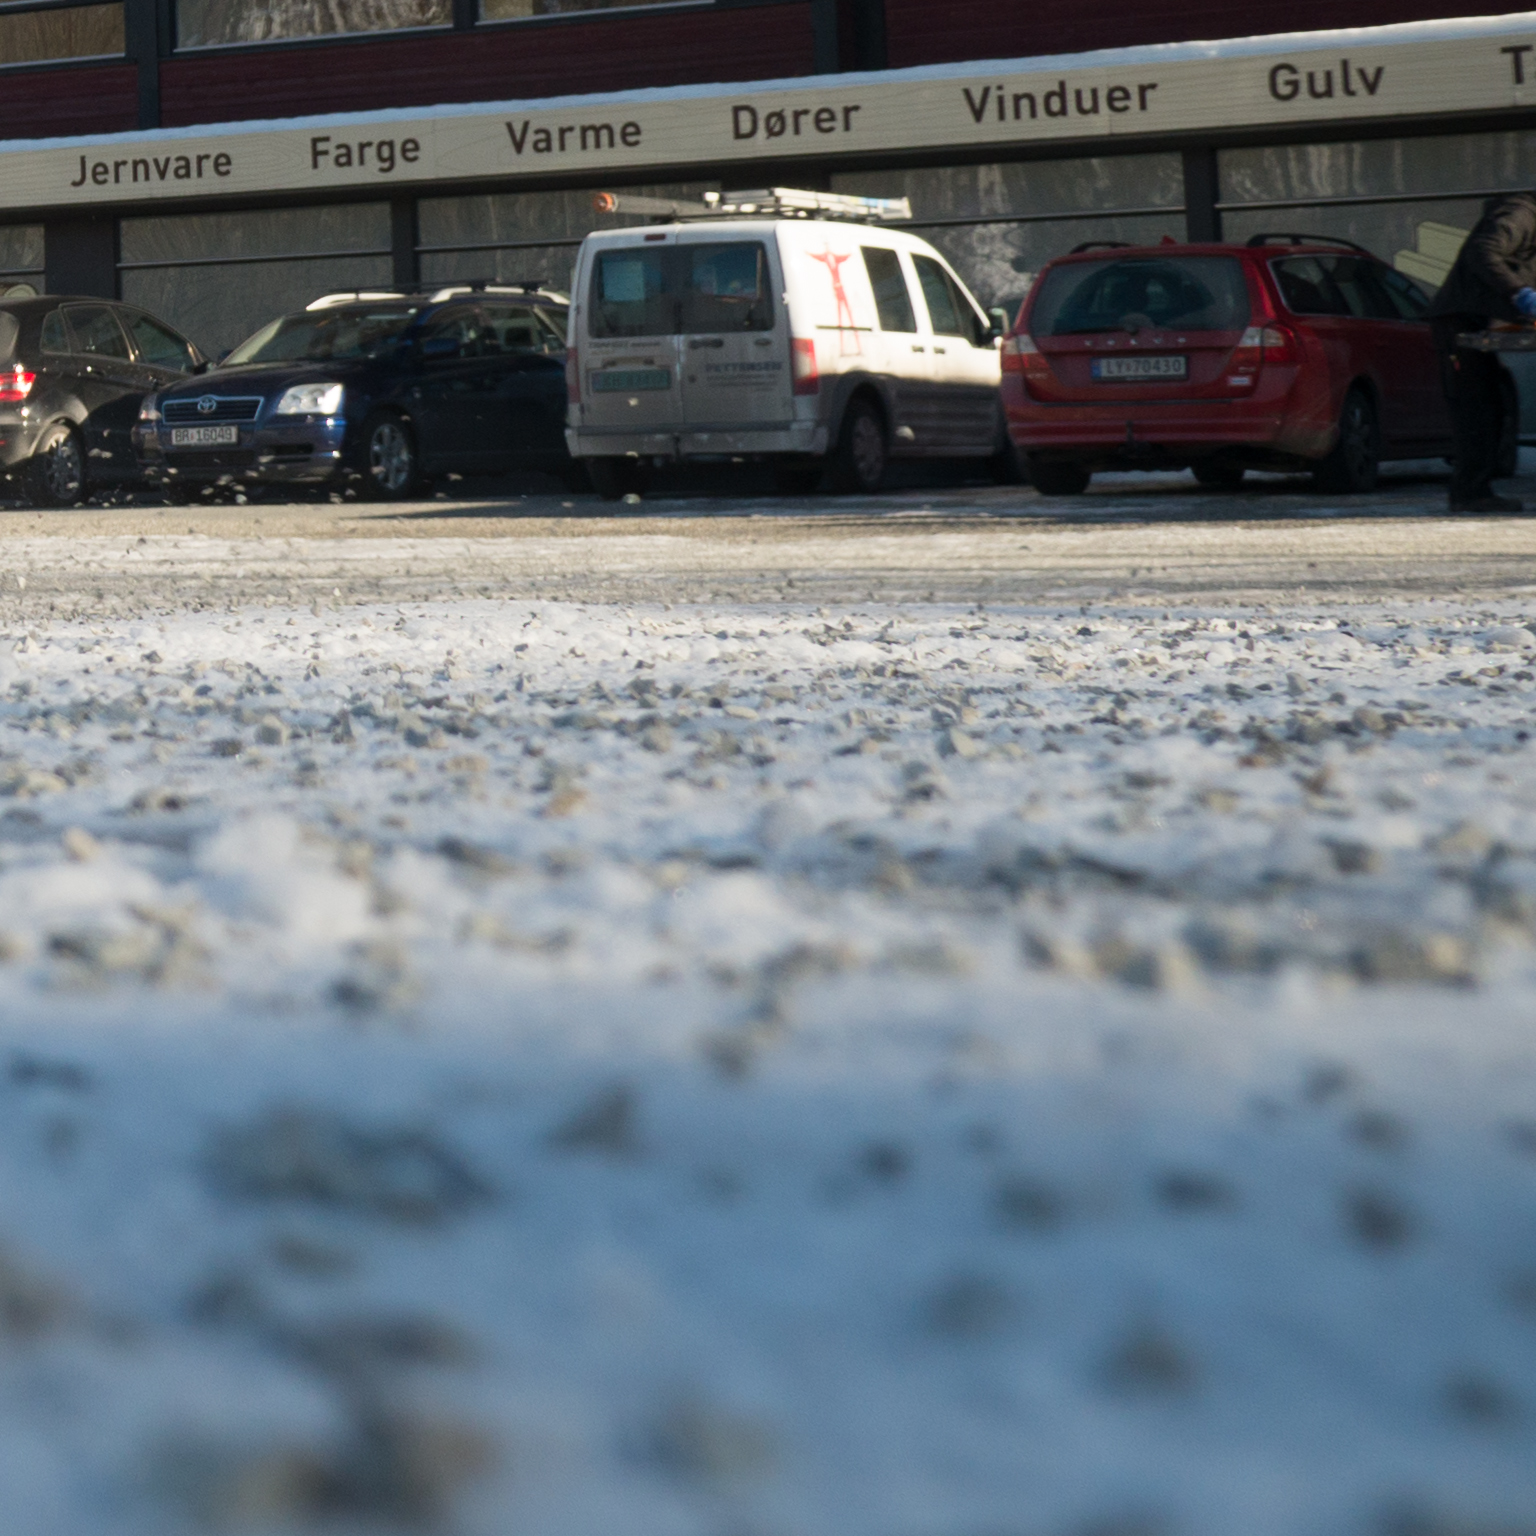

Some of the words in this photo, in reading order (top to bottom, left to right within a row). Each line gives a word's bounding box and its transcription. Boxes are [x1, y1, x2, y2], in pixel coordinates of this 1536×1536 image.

[1268, 58, 1385, 102] Gulv
[962, 79, 1159, 124] Vinduer
[505, 119, 642, 155] Varme
[731, 104, 862, 141] Dører
[70, 152, 233, 188] Jernvare
[310, 135, 421, 174] Farge
